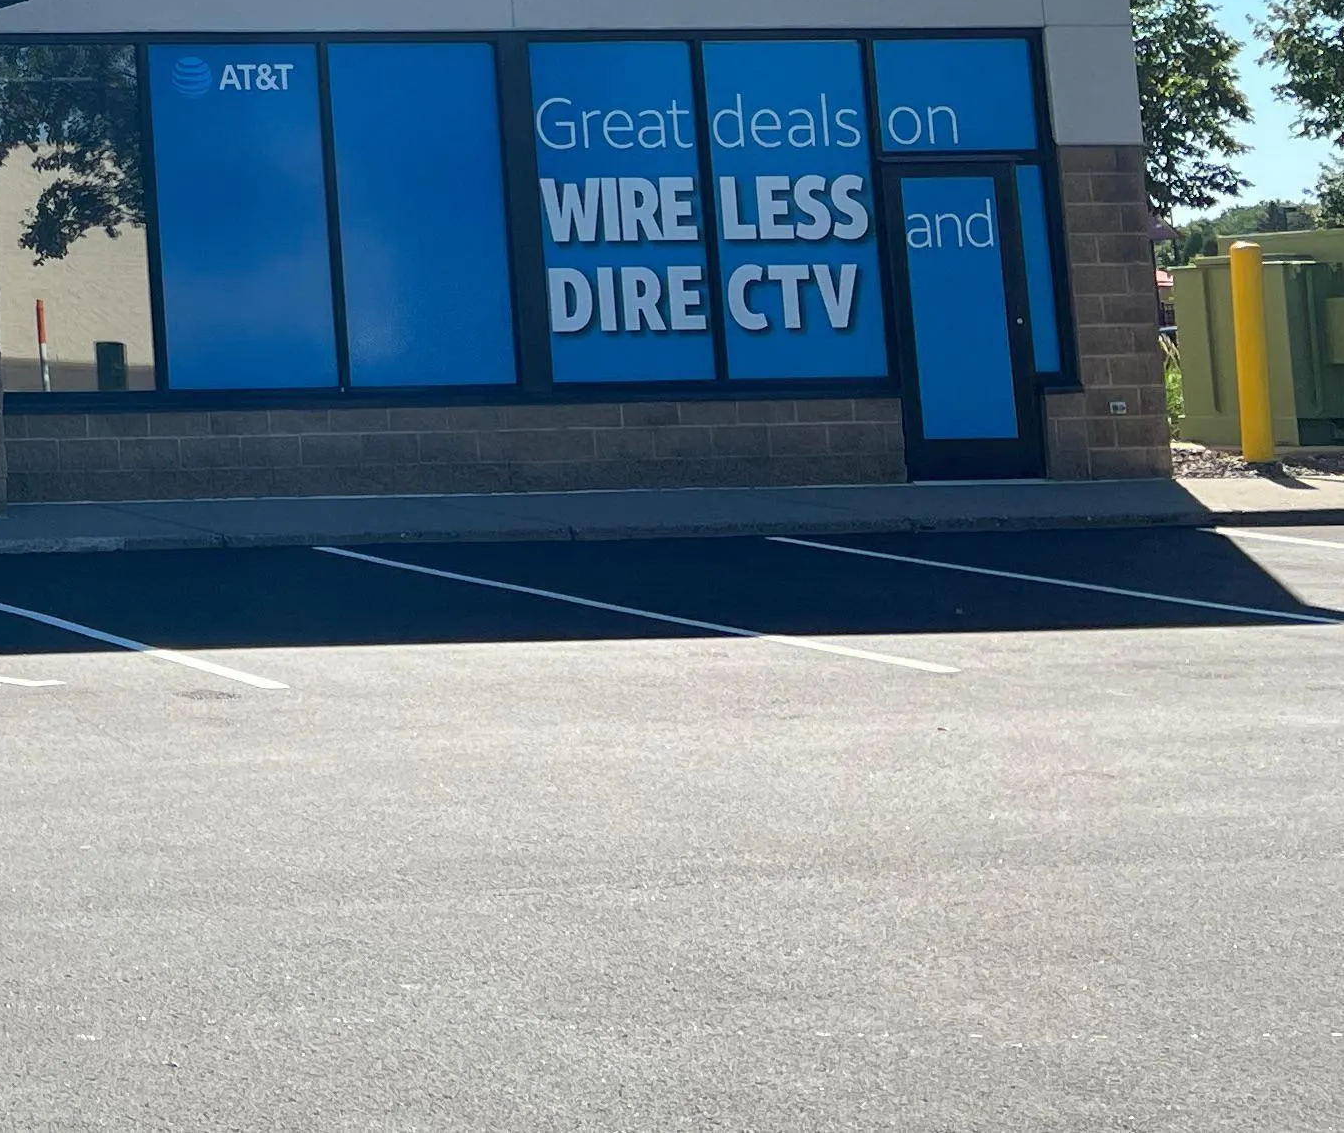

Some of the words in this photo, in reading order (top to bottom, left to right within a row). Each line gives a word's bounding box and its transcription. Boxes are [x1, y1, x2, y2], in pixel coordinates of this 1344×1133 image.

[219, 64, 294, 91] AT&T
[535, 97, 693, 149] Great
[712, 93, 862, 149] deals
[887, 103, 959, 146] on
[906, 199, 995, 248] and
